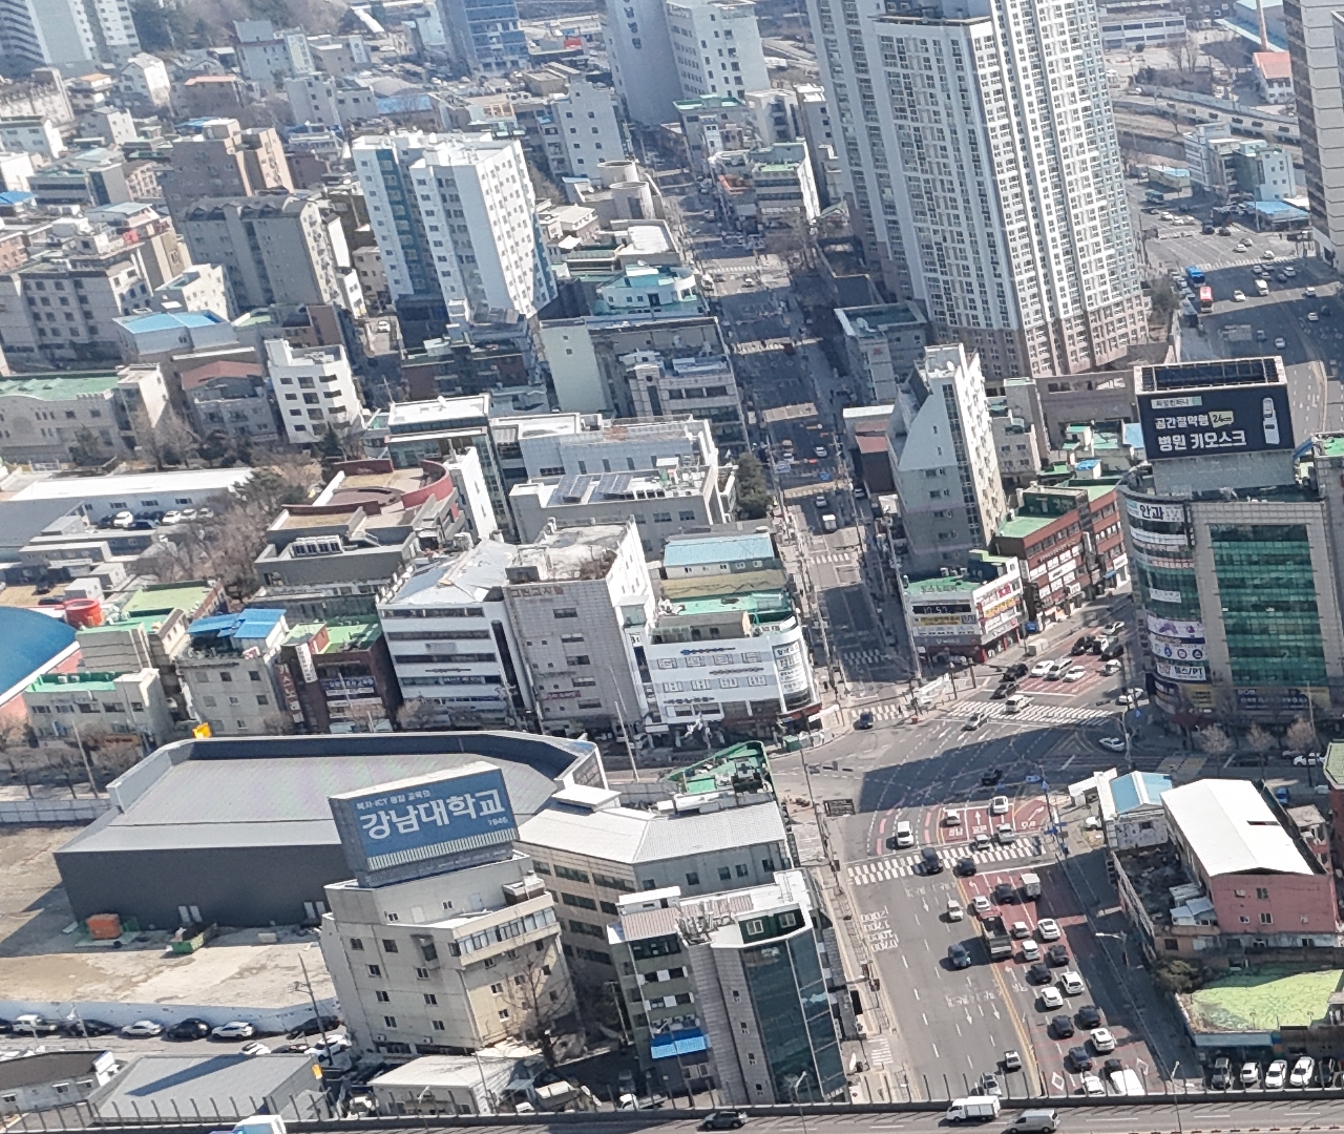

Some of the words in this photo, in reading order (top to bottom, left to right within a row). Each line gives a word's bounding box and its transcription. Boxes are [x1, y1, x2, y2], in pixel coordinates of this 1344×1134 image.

[1155, 414, 1209, 430] 공간절약형
[1158, 433, 1187, 452] 병원
[1190, 429, 1247, 450] 키오스크
[1140, 505, 1164, 520] 안과
[359, 789, 505, 840] 강남대학교
